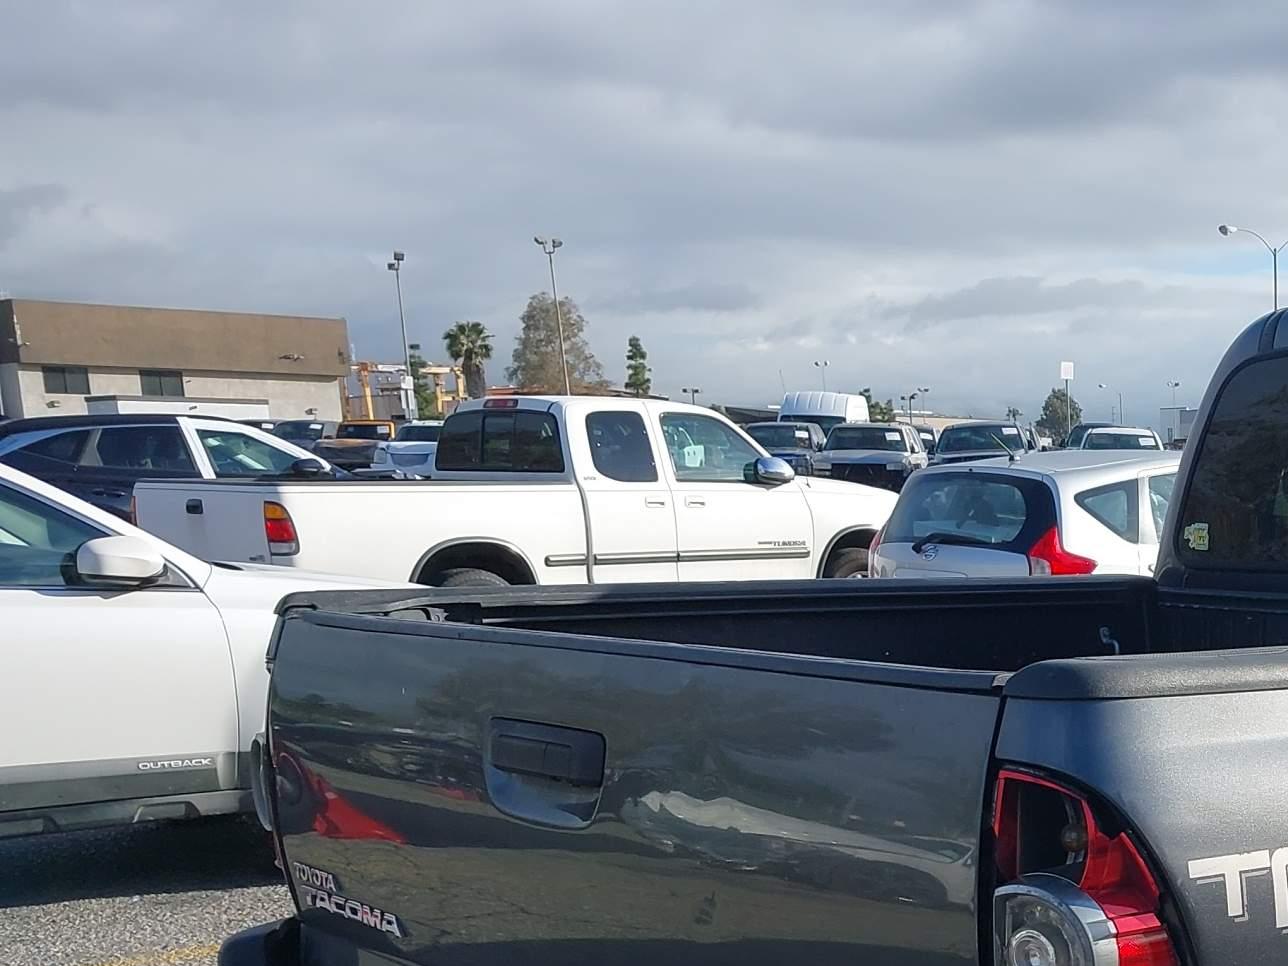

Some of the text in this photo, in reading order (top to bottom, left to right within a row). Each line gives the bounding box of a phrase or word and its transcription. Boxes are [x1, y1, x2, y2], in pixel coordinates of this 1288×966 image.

[138, 758, 213, 770] OUTBACK
[293, 861, 337, 893] TOYOTA
[301, 884, 402, 938] TACOMA
